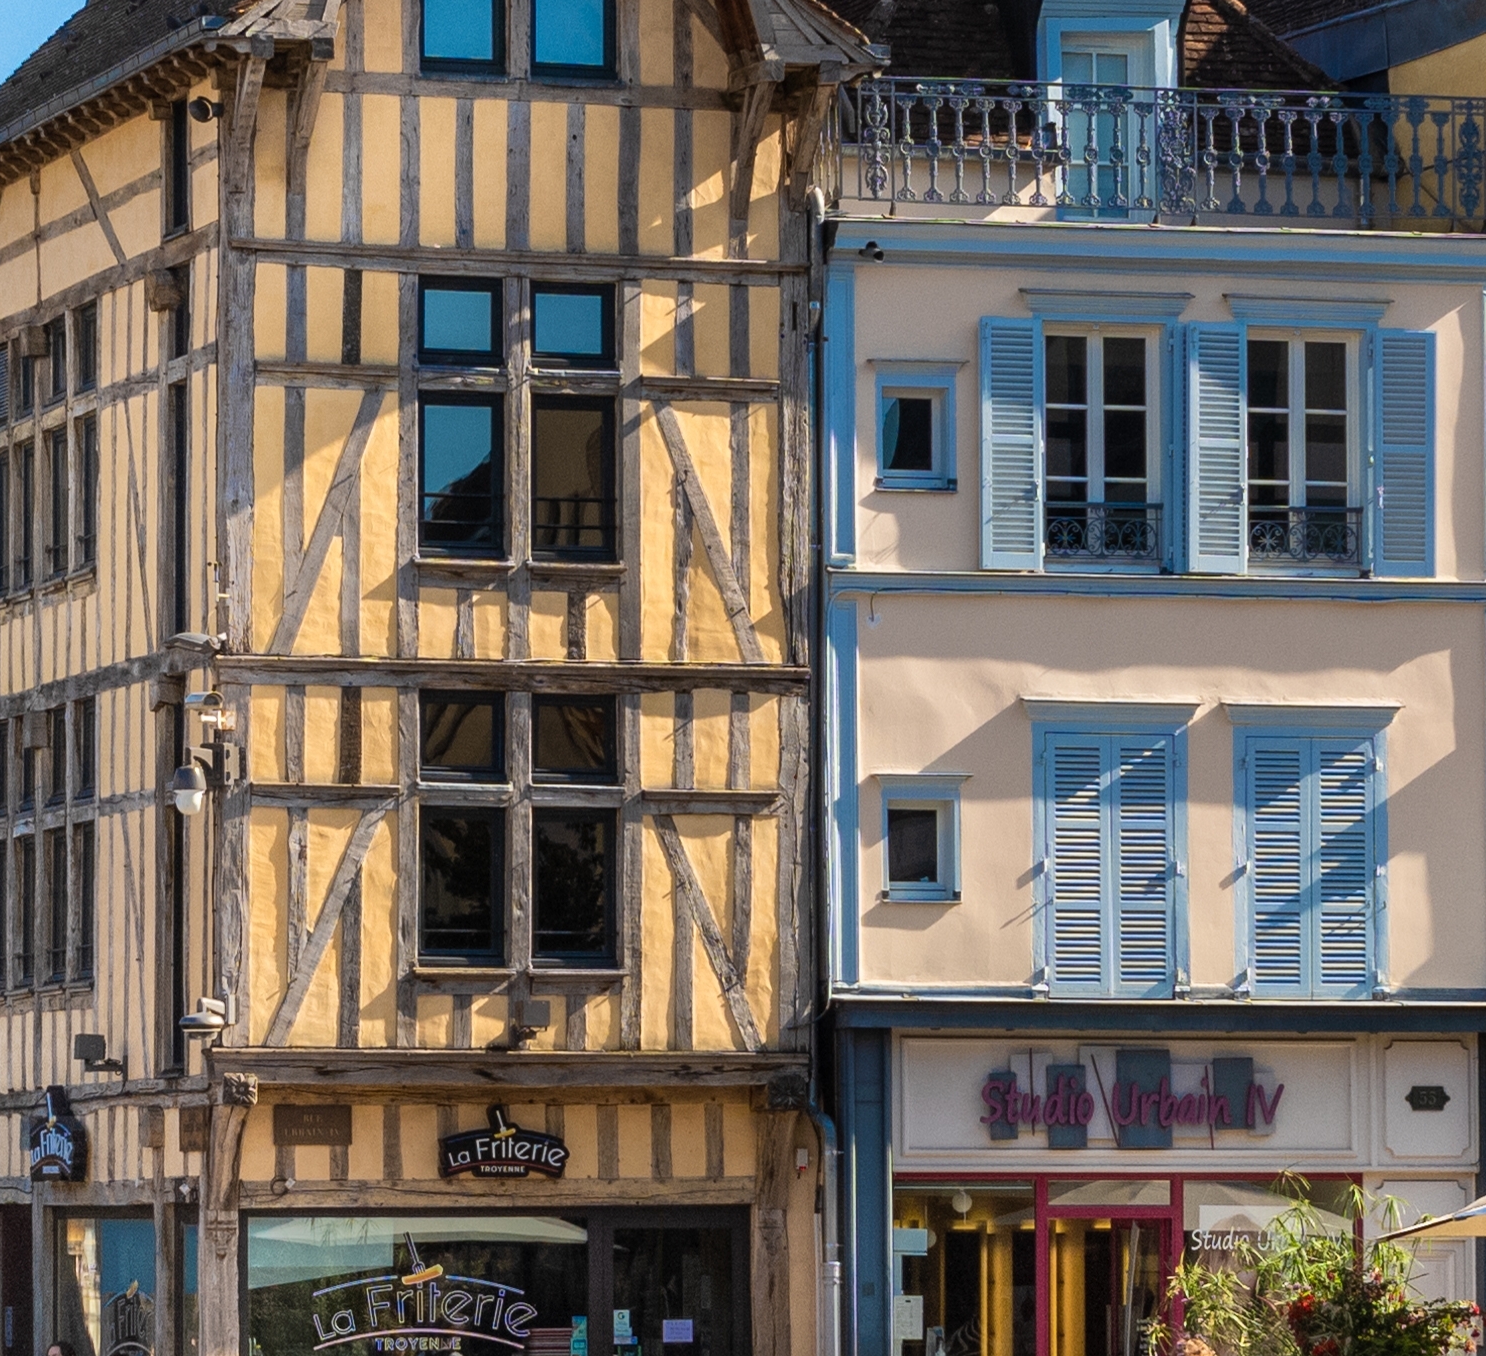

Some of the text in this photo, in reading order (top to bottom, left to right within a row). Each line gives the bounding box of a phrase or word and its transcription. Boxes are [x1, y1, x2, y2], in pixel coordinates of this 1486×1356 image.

[980, 1072, 1285, 1128] Studio Urbain IV
[30, 1146, 41, 1167] La
[448, 1135, 566, 1167] La Friterie
[480, 1165, 526, 1174] TROYENNE
[313, 1281, 538, 1341] La Friterie
[374, 1337, 463, 1351] TROYENNE
